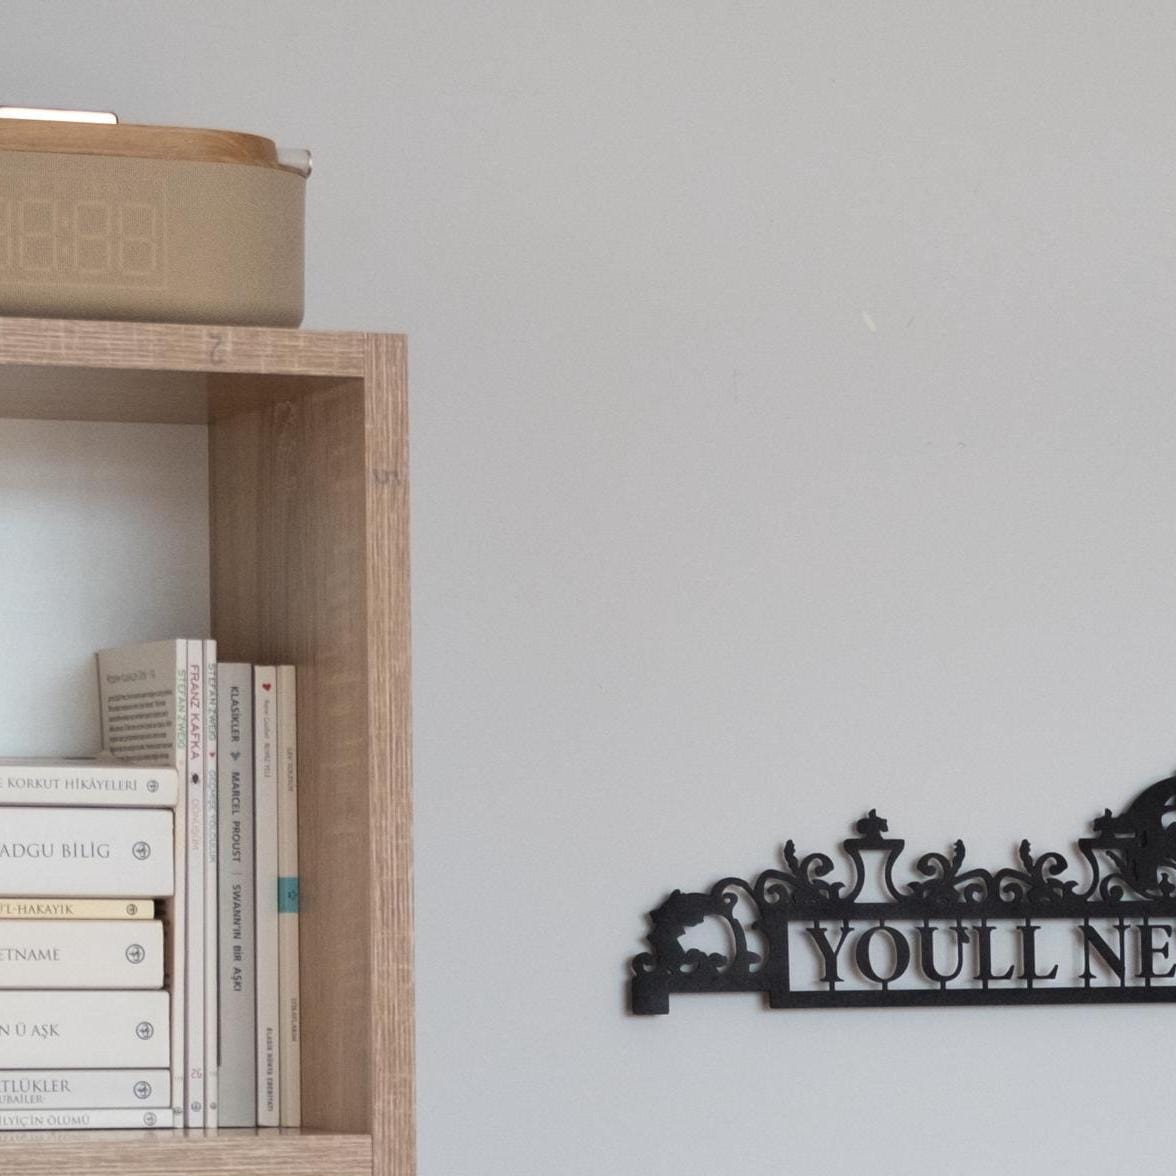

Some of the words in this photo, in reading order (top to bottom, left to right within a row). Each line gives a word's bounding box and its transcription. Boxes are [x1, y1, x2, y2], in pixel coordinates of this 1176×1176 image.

[177, 670, 186, 714] STEFAN
[189, 664, 200, 708] FRANZ
[229, 686, 241, 742] KLASİKLER
[190, 712, 200, 760] KAFKA
[7, 777, 60, 790] KORKUT
[231, 772, 241, 815] MARCEL
[0, 843, 54, 858] ADGU
[231, 821, 242, 863] PROUST
[232, 945, 242, 962] BİR
[31, 1023, 60, 1040] AŞK
